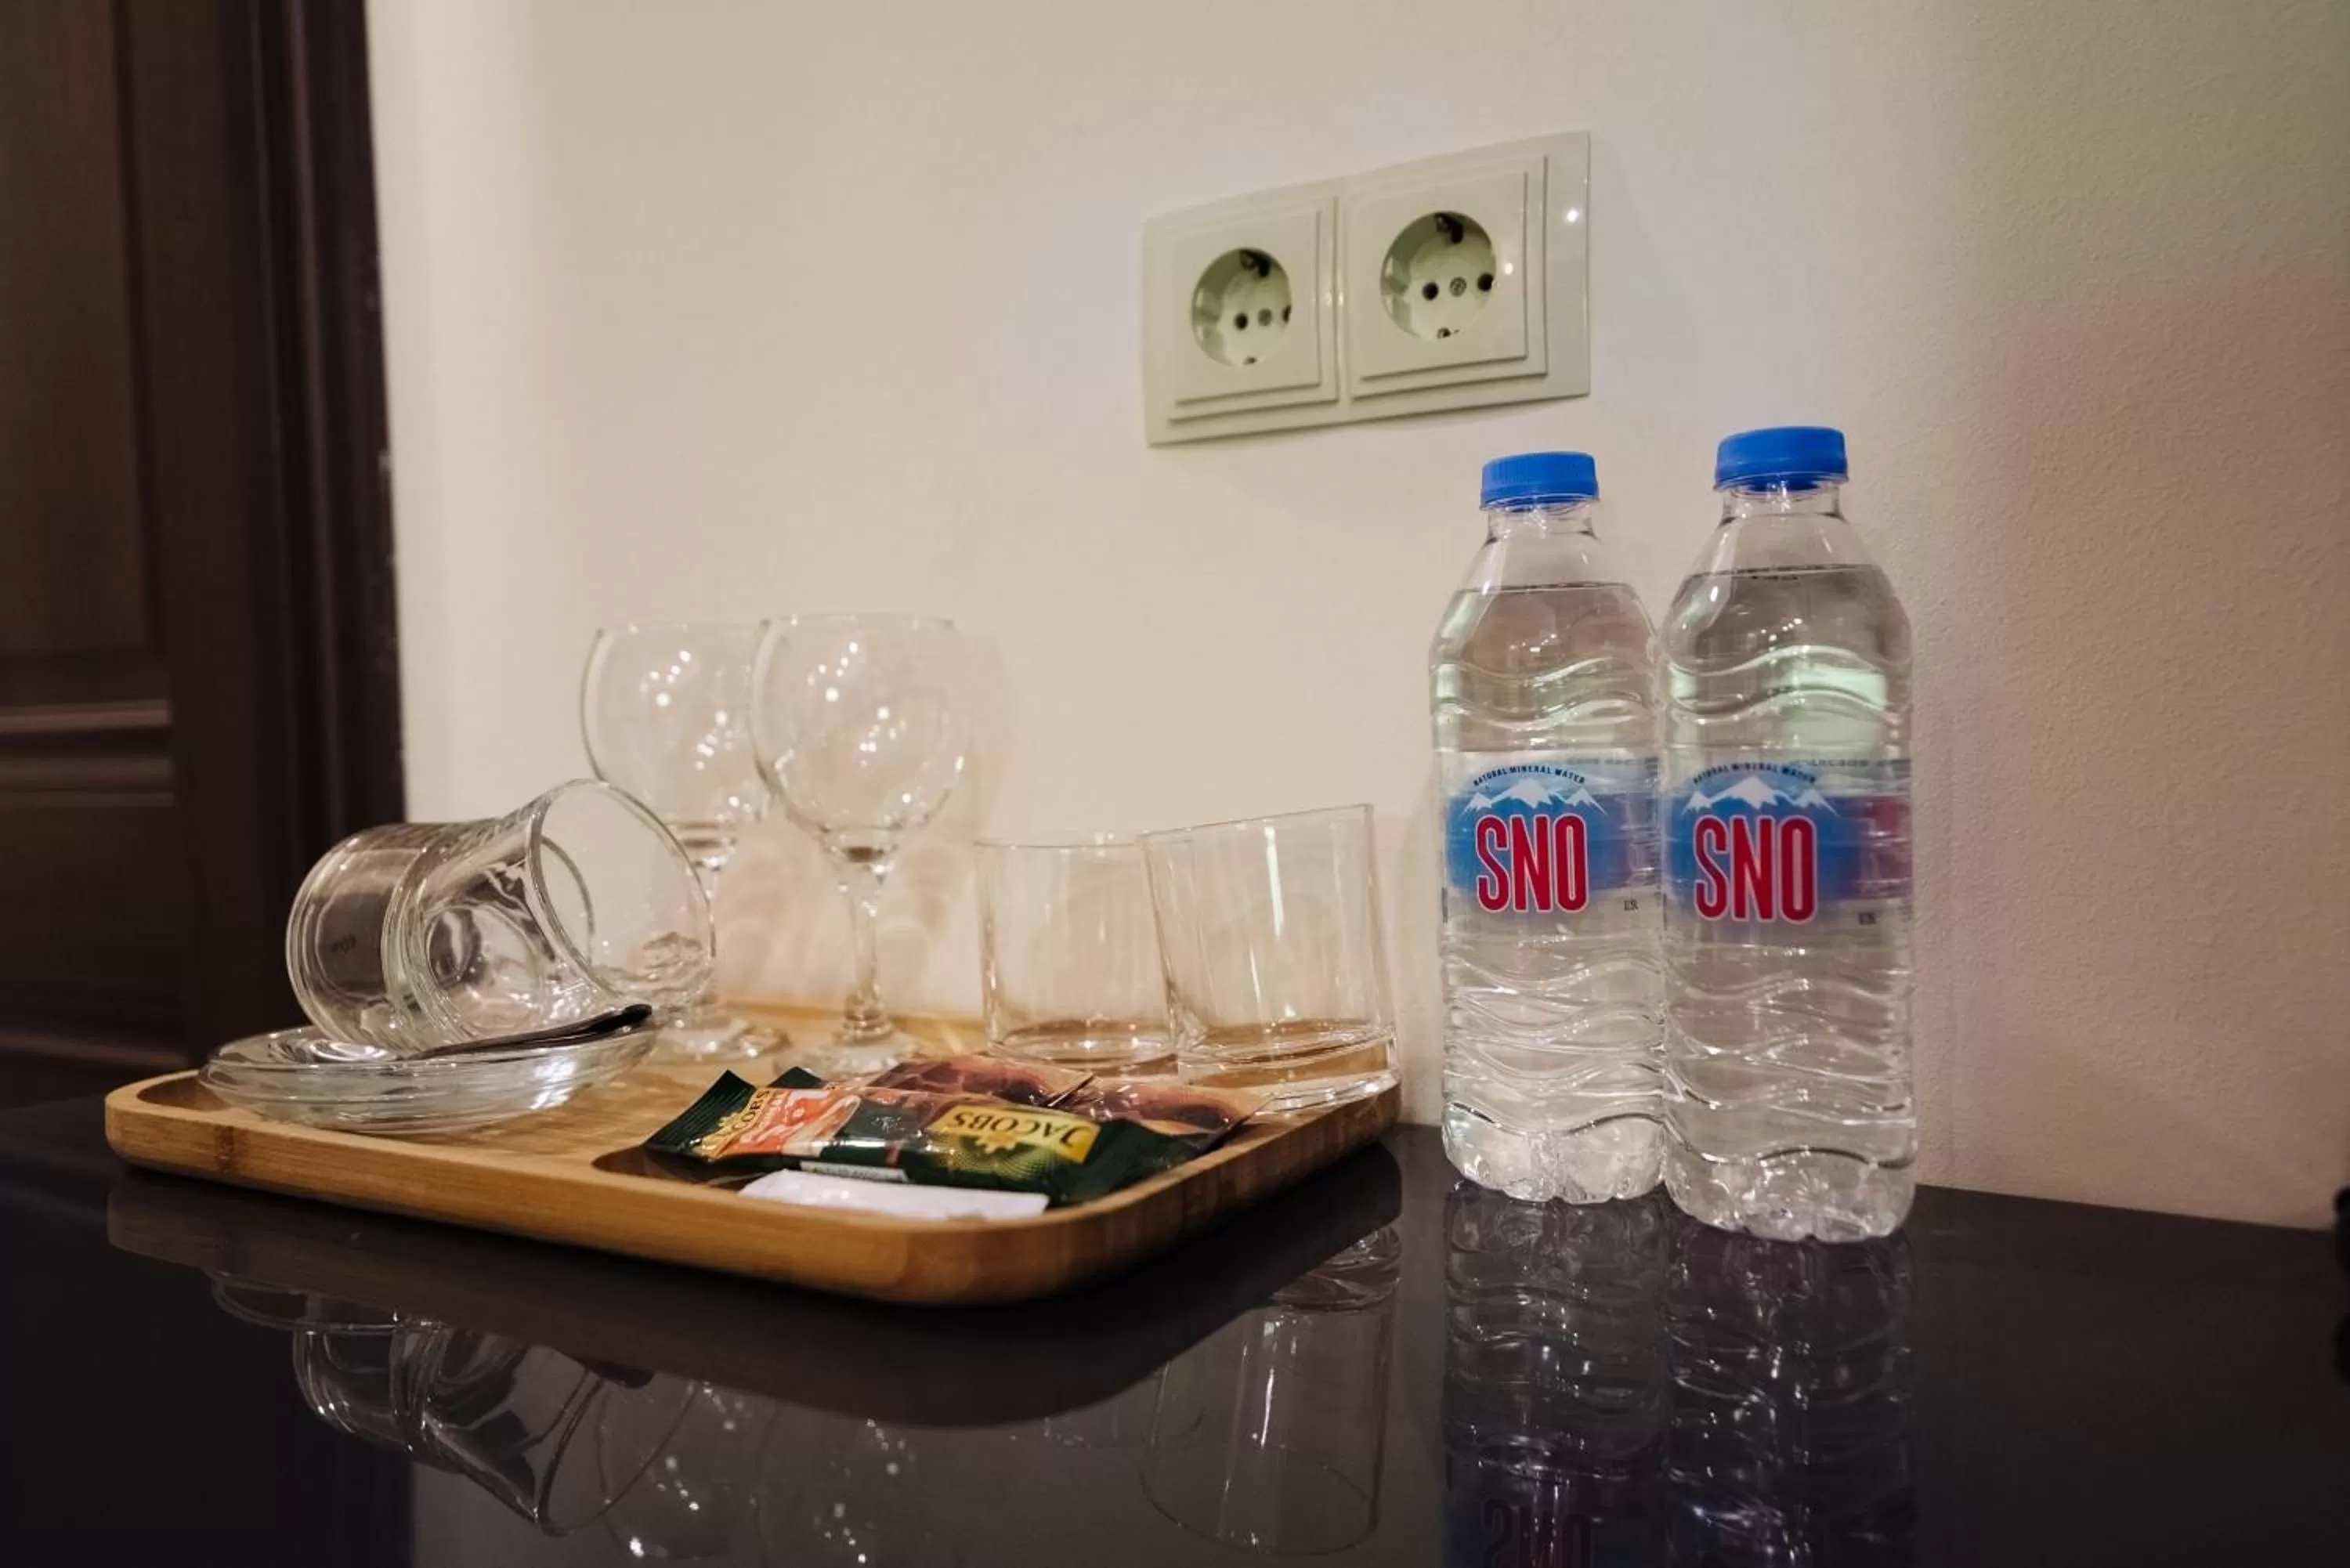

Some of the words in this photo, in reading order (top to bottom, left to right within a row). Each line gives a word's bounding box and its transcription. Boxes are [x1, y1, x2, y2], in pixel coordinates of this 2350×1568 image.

[1473, 766, 1508, 786] NATURAL
[1509, 764, 1551, 775] MINERAL
[1554, 768, 1585, 784] WATER
[1476, 813, 1589, 913] SNO
[1693, 814, 1818, 925] SNO
[945, 1110, 1093, 1149] JACOBS
